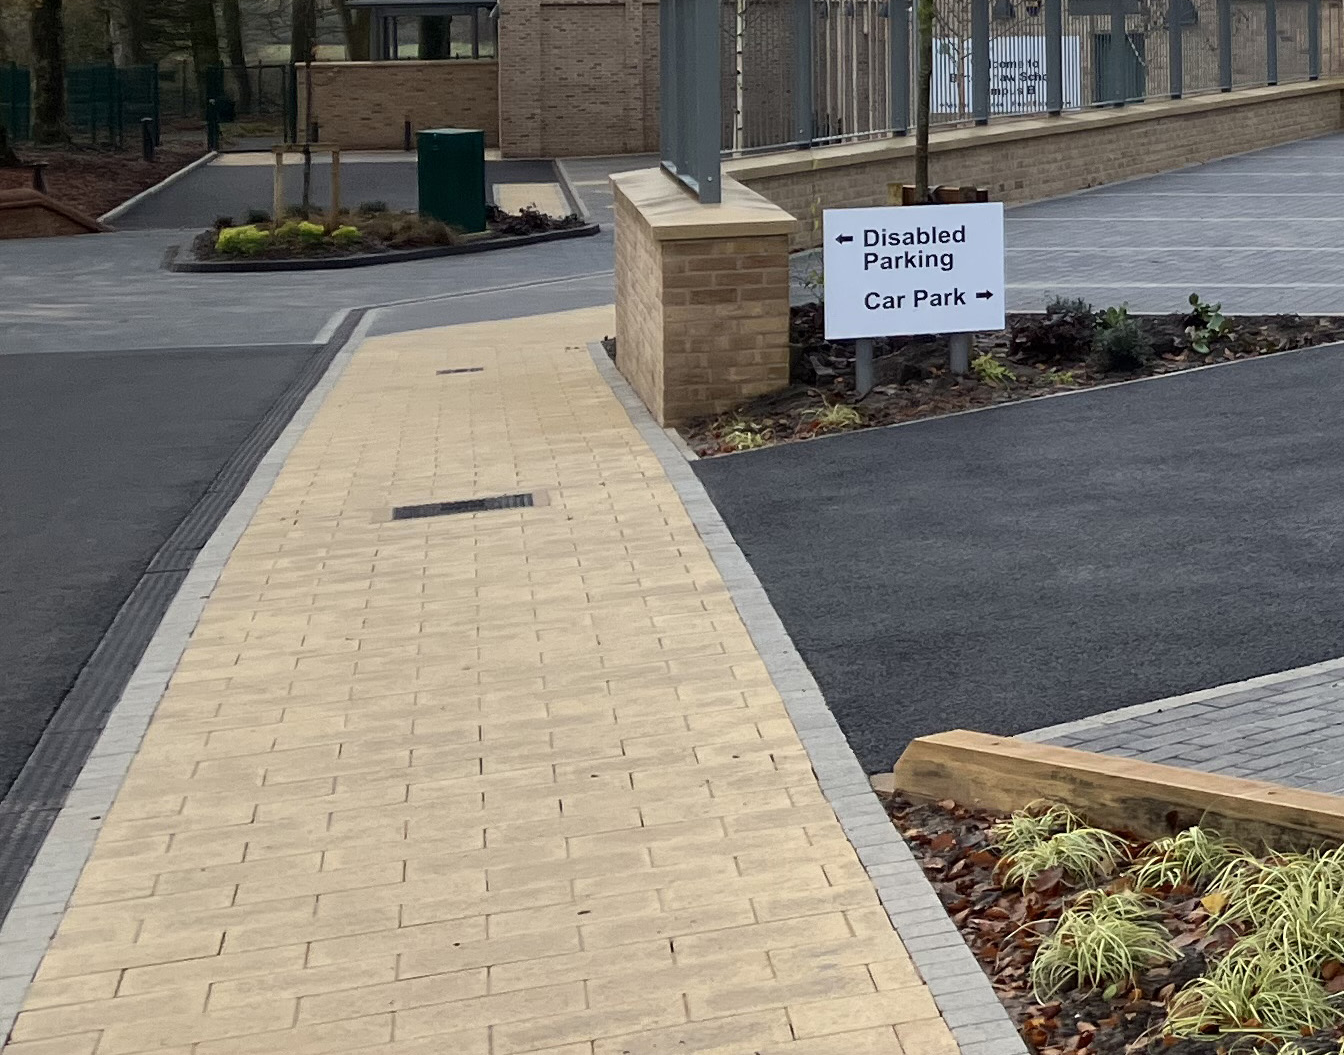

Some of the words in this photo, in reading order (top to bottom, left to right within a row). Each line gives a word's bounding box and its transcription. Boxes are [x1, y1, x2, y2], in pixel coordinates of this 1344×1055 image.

[863, 225, 966, 247] Disabled
[864, 250, 954, 271] Parking
[864, 291, 906, 310] Car
[913, 288, 966, 308] Park
